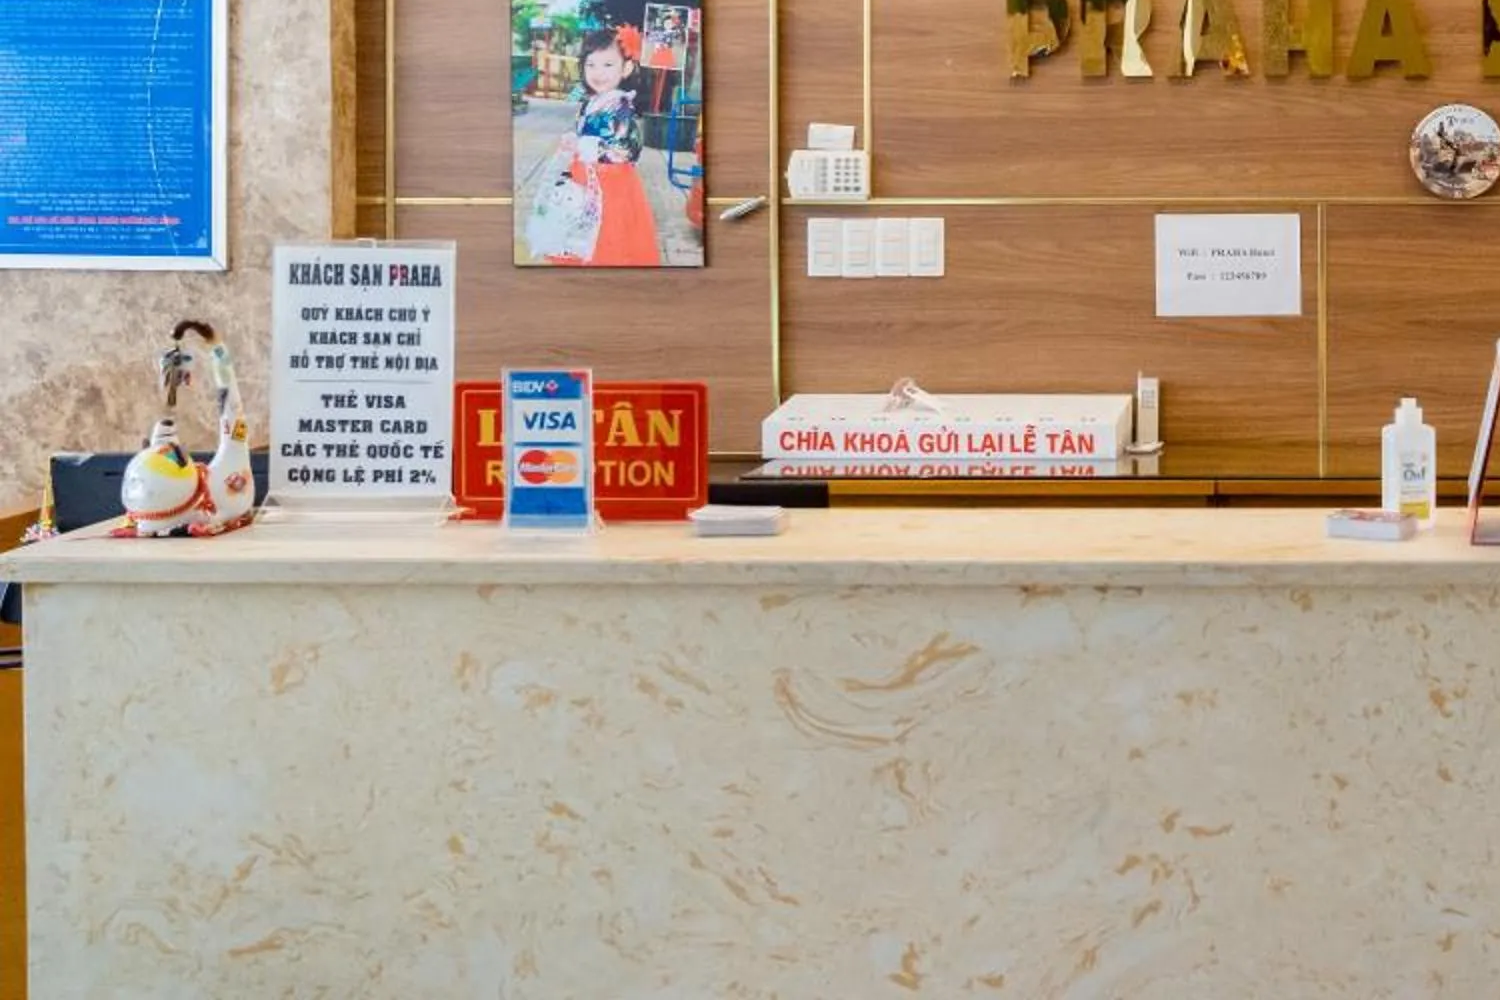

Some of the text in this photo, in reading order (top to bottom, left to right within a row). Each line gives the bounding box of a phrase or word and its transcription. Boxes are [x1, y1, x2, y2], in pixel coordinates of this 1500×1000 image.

[289, 256, 442, 292] KHÁCH SẠN PRAHA
[335, 303, 383, 321] KHÁCH
[388, 304, 417, 322] CHÚ
[309, 328, 357, 345] KHÁCH
[363, 332, 391, 348] SẠN
[512, 381, 544, 393] BIDV
[320, 390, 406, 409] THẺ VISA
[298, 419, 428, 434] MASTER CARD
[523, 411, 577, 431] VISA
[281, 439, 445, 459] CÁC THẺ QUỐC TẾ
[779, 424, 1095, 457] CHÌA KHOÁ GỬI LẠI LỄ TÂN
[288, 465, 337, 486] CỘNG
[372, 466, 404, 484] PHÍ
[409, 469, 437, 484] 2%
